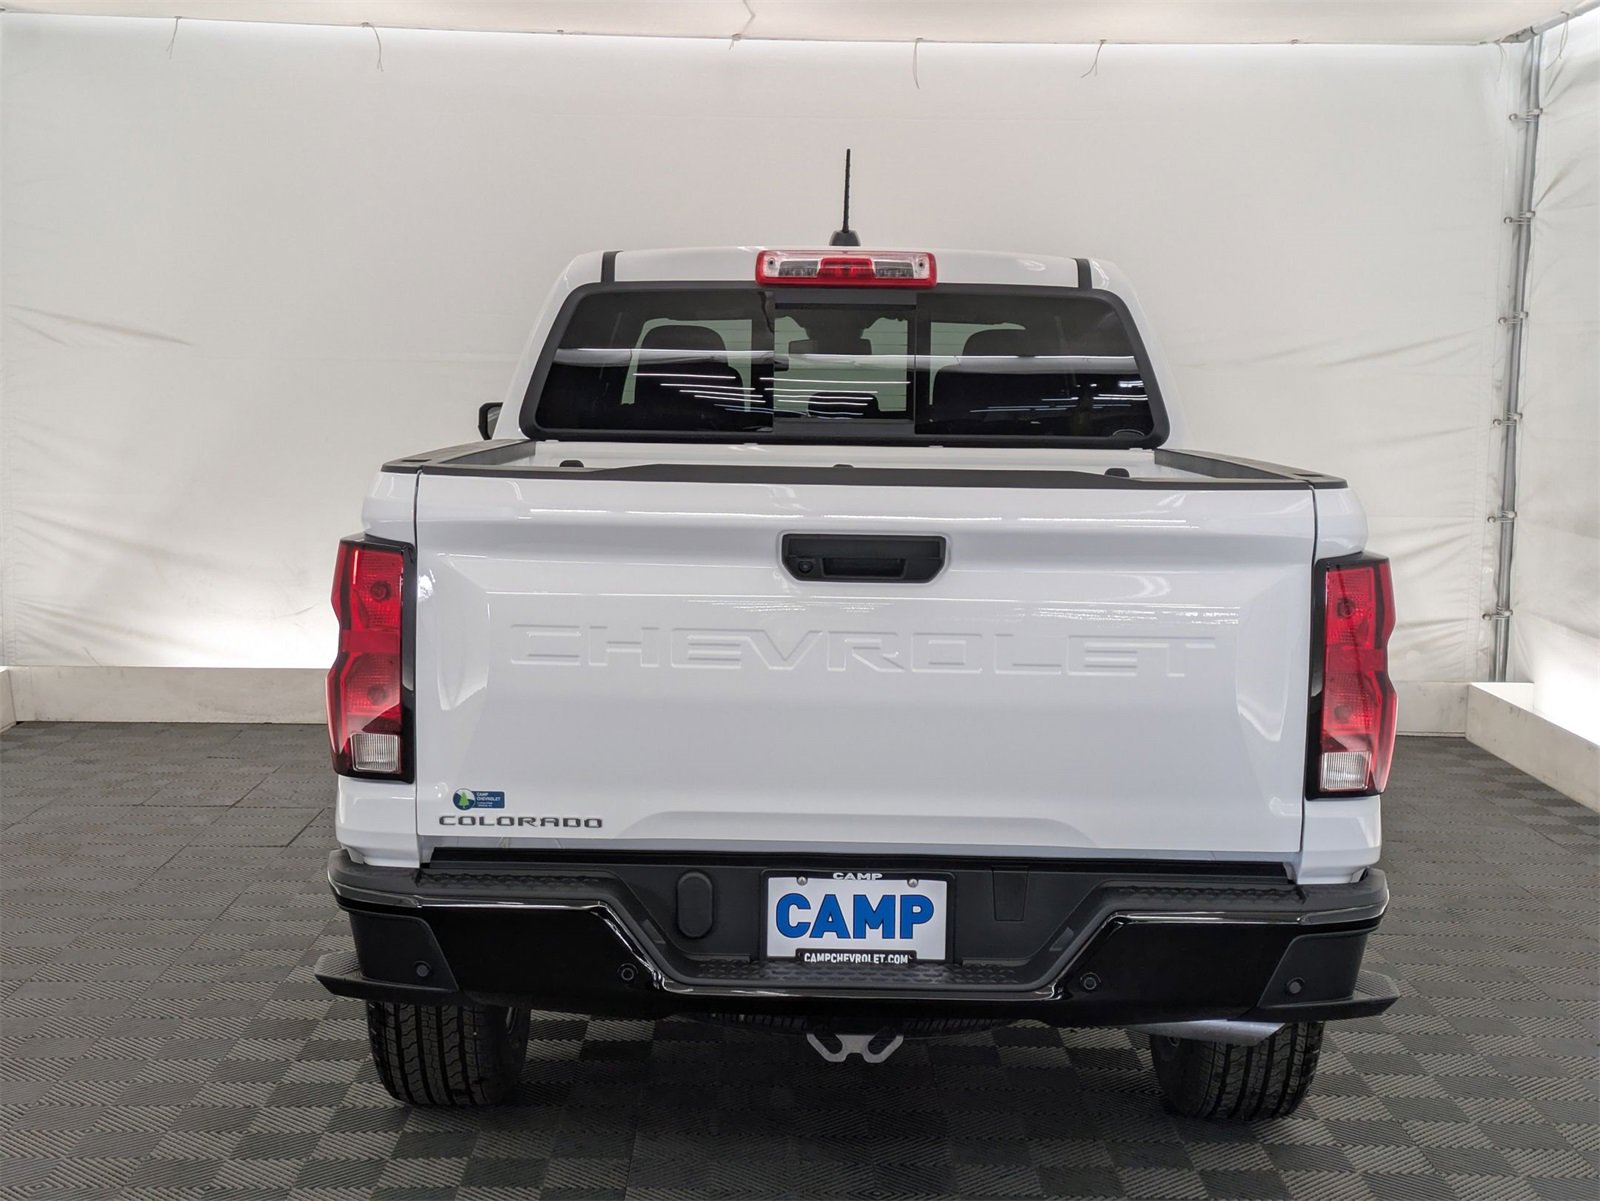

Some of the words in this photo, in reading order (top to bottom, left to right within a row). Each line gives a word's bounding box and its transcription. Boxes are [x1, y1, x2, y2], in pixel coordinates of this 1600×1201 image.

[511, 624, 1216, 677] CHEVROLET
[439, 815, 603, 829] COLORADO
[832, 872, 883, 881] CAMP
[775, 892, 935, 940] CAMP
[804, 952, 909, 964] CAMPCHEVROLET.COM
